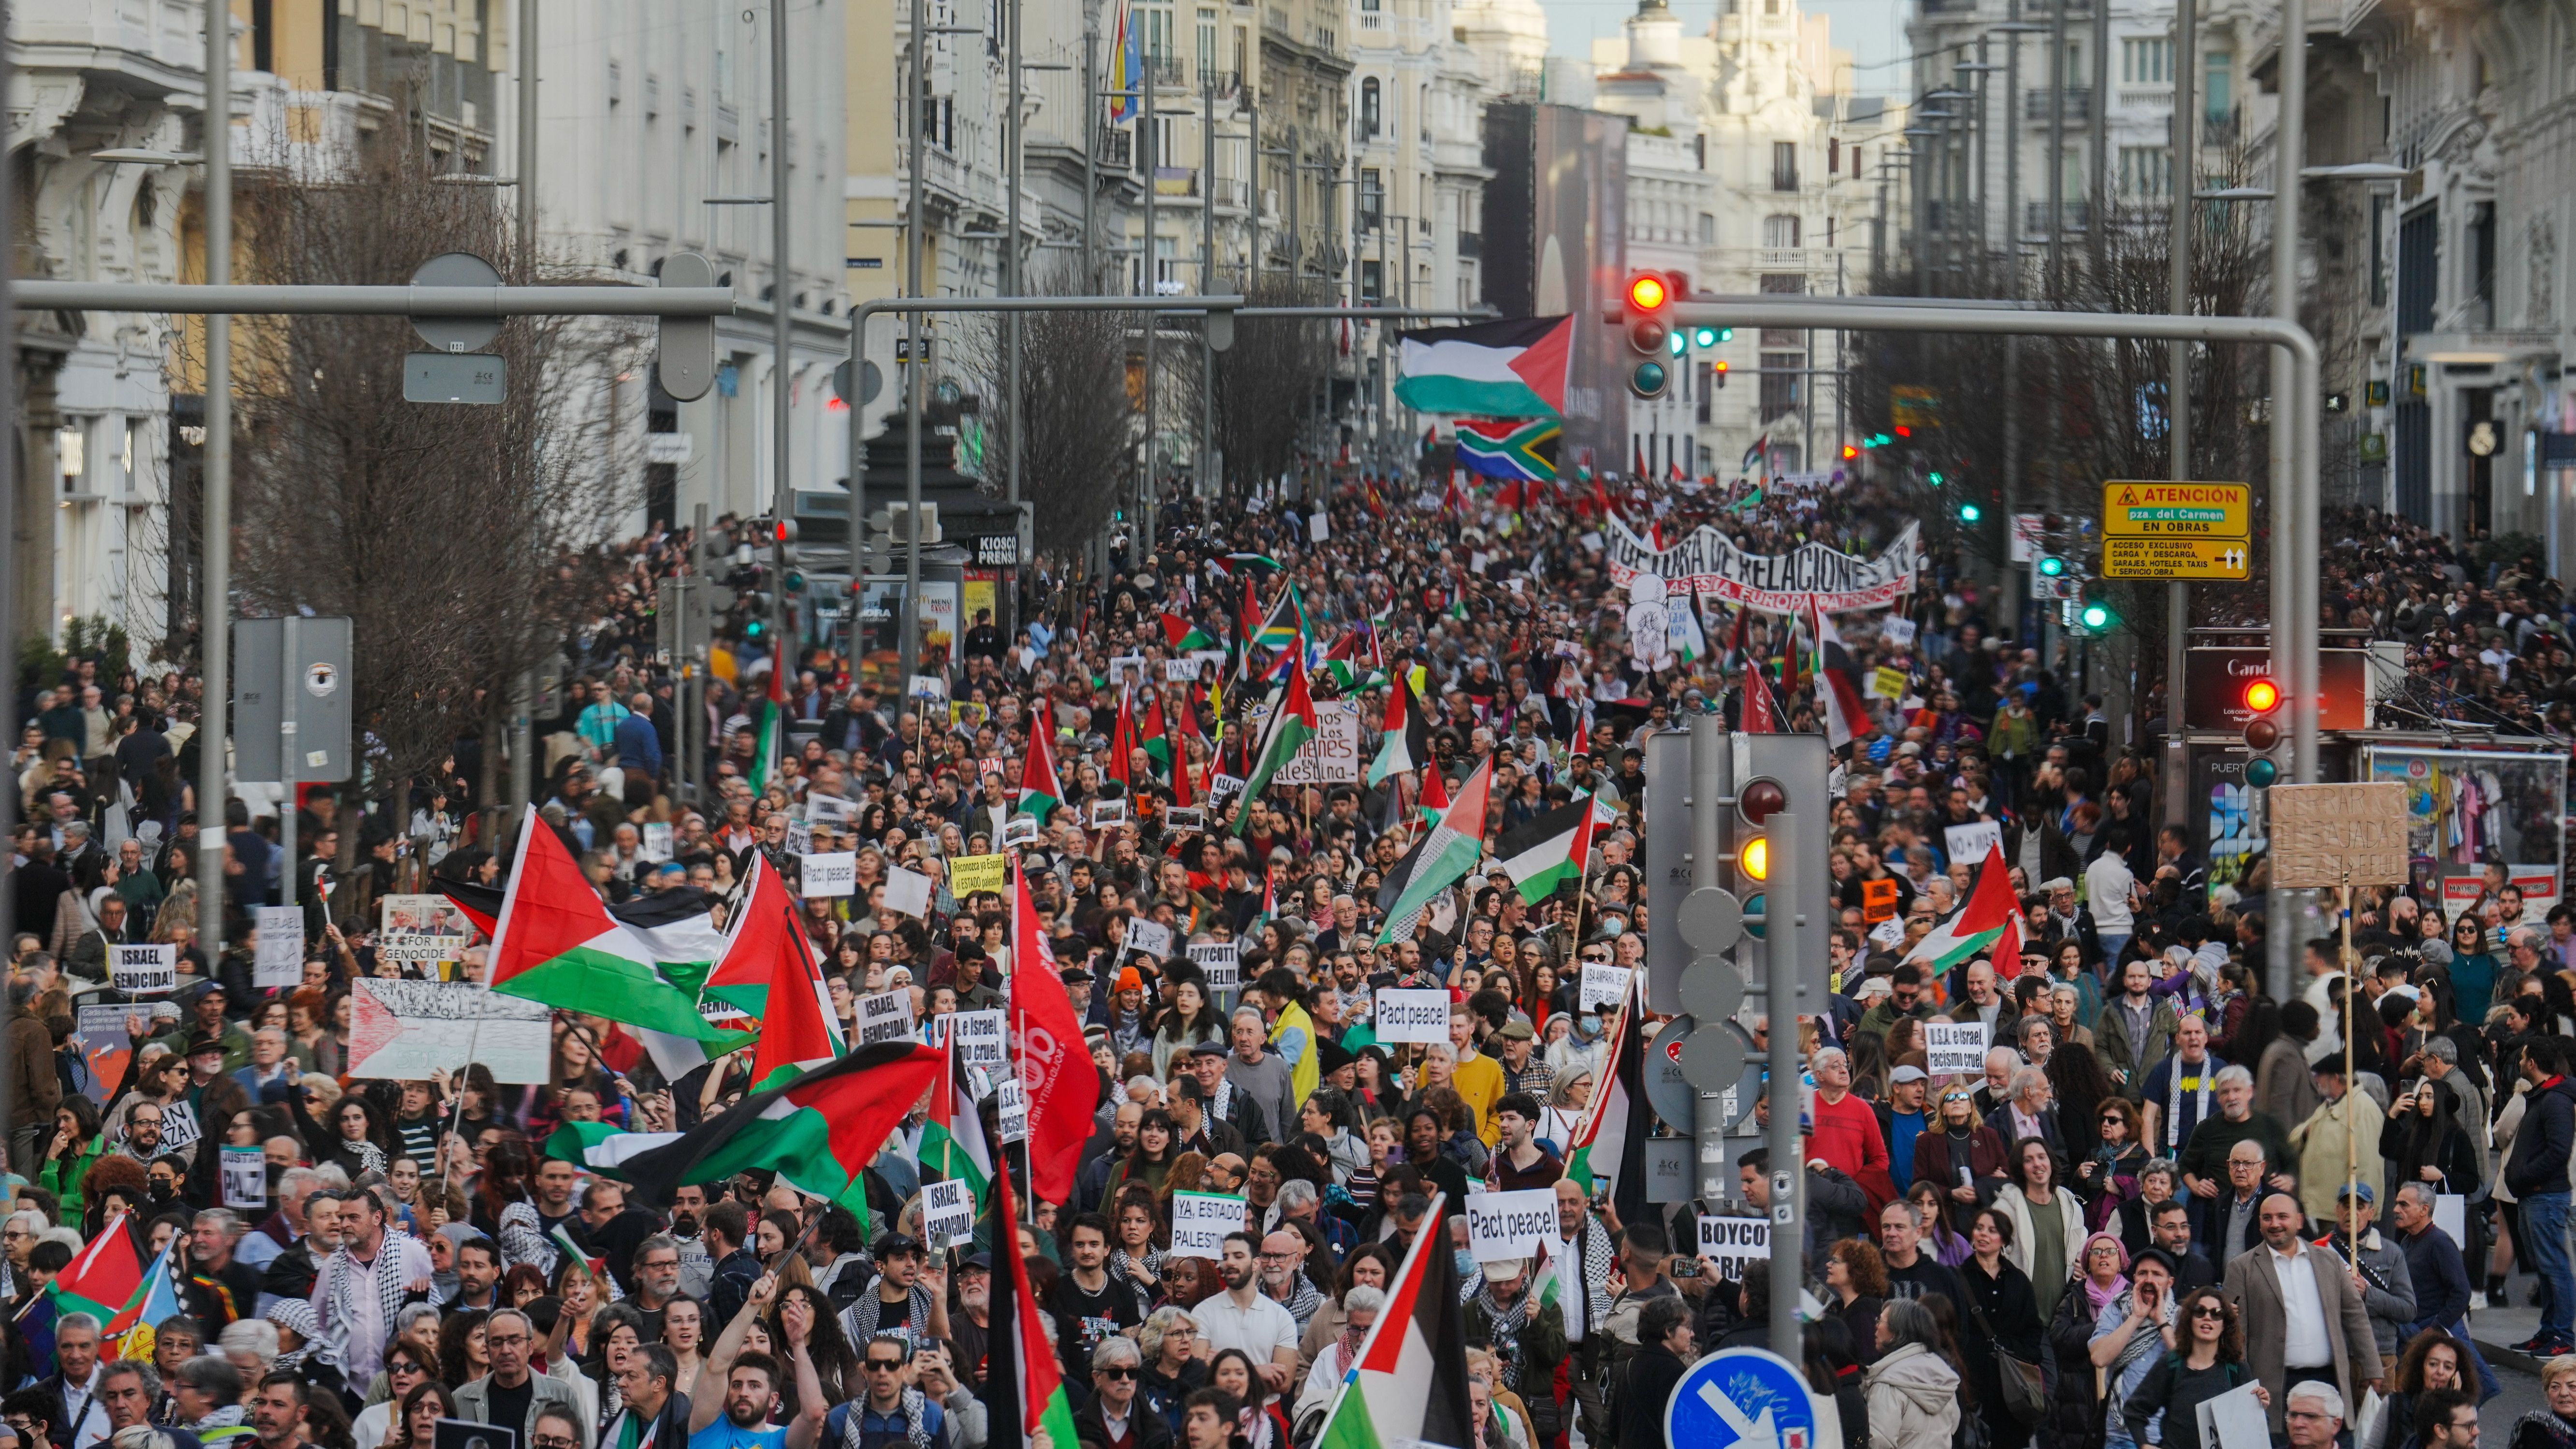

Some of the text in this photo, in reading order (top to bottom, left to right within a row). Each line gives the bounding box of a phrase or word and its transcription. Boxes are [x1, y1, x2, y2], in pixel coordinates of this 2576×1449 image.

[2144, 485, 2238, 503] ATENCIÓN
[2129, 509, 2224, 521] pza. del Carmen
[2143, 522, 2210, 532] EN OBRAS
[980, 536, 1016, 551] KIOSCO
[2113, 541, 2144, 550] ACCESO
[979, 550, 1017, 565] PRENSA
[2154, 551, 2198, 559] DESCARGA,
[1740, 546, 1880, 592] RELACIONES
[2118, 567, 2152, 576] SERVICIO
[2154, 568, 2175, 576] OBRA
[787, 832, 805, 854] PAZ
[953, 856, 1003, 876] ¡Reconozca ya España
[956, 873, 1002, 890] el ESTADO palestino!
[408, 936, 432, 946] FOR
[122, 949, 163, 966] ISRAEL,
[385, 949, 446, 959] GENOCIDE
[1189, 947, 1235, 962] BOYCOTT
[113, 970, 174, 989] GENOCIDA!
[1206, 969, 1236, 985] AEL!!!
[1586, 968, 1595, 983] USA
[865, 995, 898, 1018] ISRAEL,
[1379, 1000, 1447, 1031] Pact peace!
[963, 1021, 969, 1037] e
[971, 1016, 1000, 1037] Israel,
[1954, 1030, 1959, 1045] e
[1959, 1028, 1983, 1048] Israel,
[974, 1041, 1002, 1061] cruel.
[1930, 1049, 1984, 1069] racismo cruel.
[222, 1169, 264, 1203] PAZ
[930, 1182, 961, 1209] ISRAEL,
[1199, 1201, 1242, 1221] ESTADO
[927, 1212, 970, 1243] GENOCIDA!
[1470, 1203, 1556, 1245] Pact peace!
